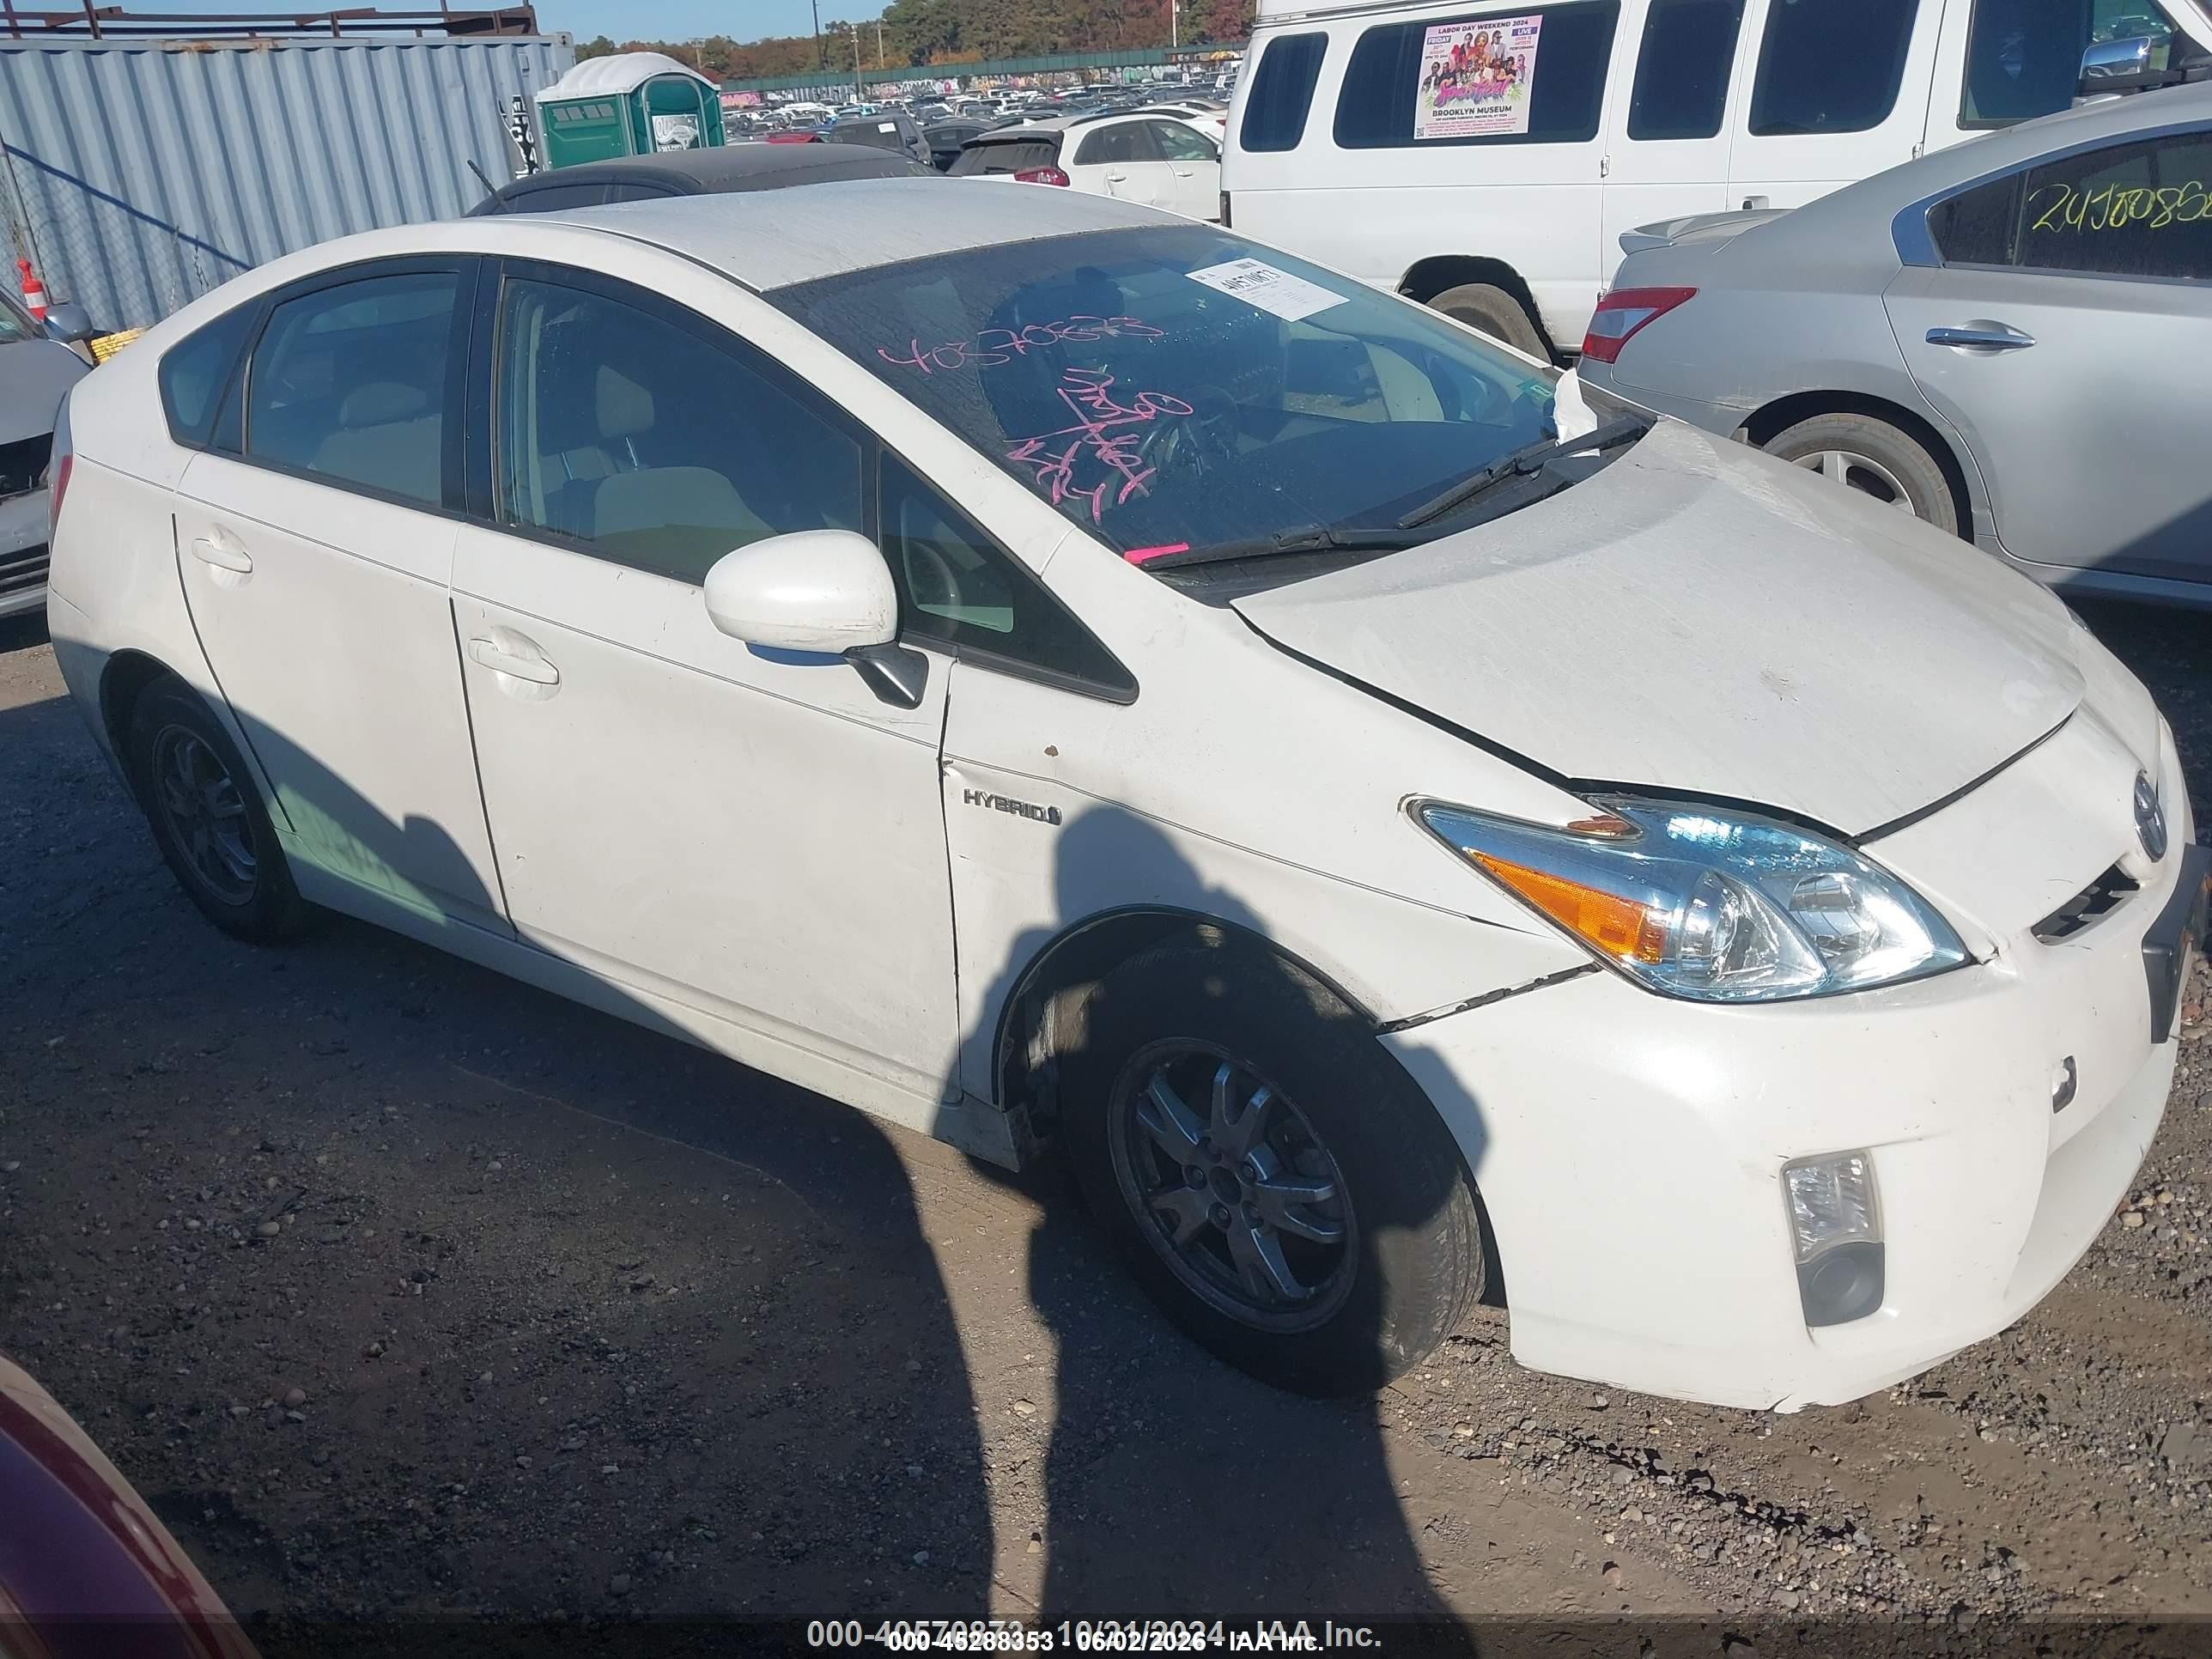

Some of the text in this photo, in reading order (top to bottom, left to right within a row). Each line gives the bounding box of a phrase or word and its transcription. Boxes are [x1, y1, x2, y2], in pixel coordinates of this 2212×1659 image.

[1477, 21, 1511, 30] WEEKEND
[1432, 105, 1512, 117] BROOKLYN MUSEUM
[1219, 269, 1281, 290] 40570873
[964, 788, 1047, 822] HYBRID
